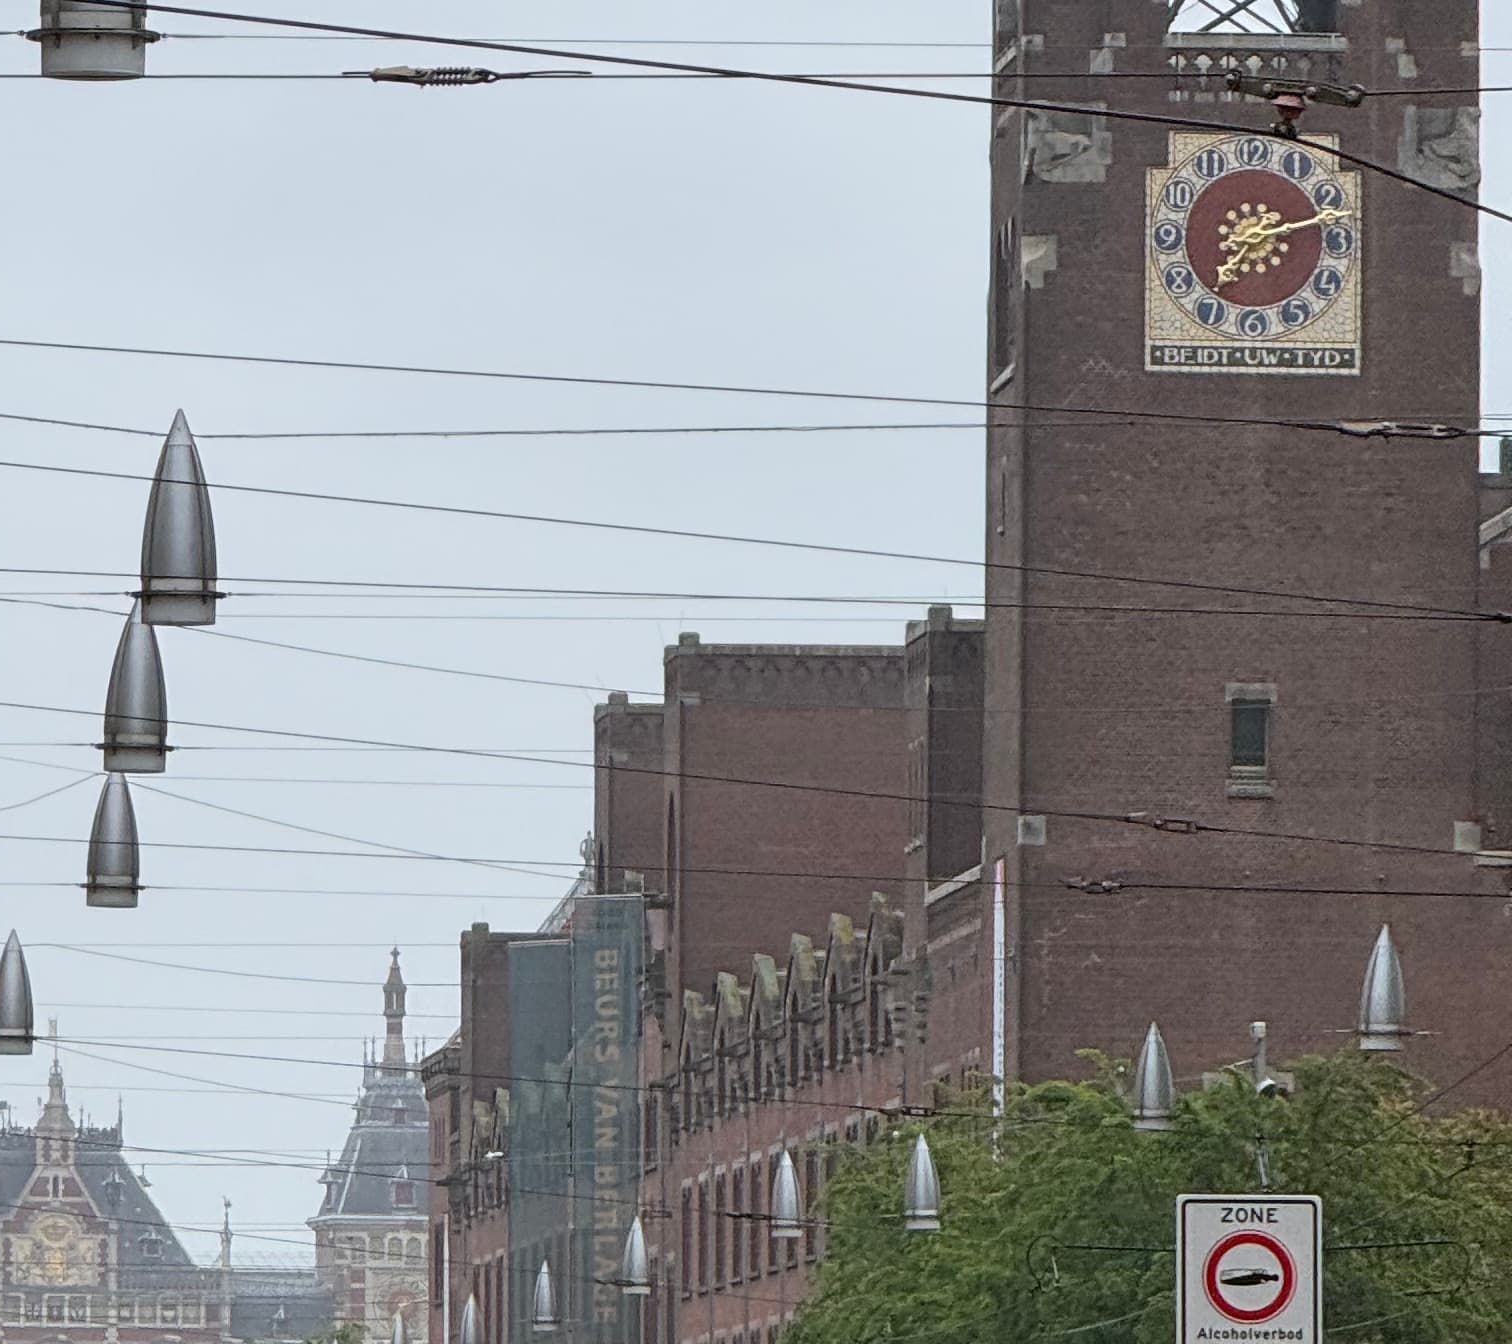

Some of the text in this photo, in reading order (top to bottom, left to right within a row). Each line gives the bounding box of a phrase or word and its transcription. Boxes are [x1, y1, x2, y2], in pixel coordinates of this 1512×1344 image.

[1242, 141, 1266, 163] 12
[1202, 153, 1219, 176] 11
[1168, 187, 1190, 208] 10
[1321, 186, 1336, 205] 2
[1162, 224, 1175, 247] 9
[1332, 227, 1348, 251] 3
[1172, 271, 1186, 292] 8
[1321, 272, 1336, 295] 4
[1204, 300, 1218, 324] 7
[1246, 311, 1260, 335] 6
[1290, 300, 1305, 325] 5
[594, 949, 620, 1062] BEURS
[594, 1079, 619, 1148] VAN
[1220, 1207, 1279, 1223] ZONE
[1196, 1327, 1303, 1340] Alcoholverbod
